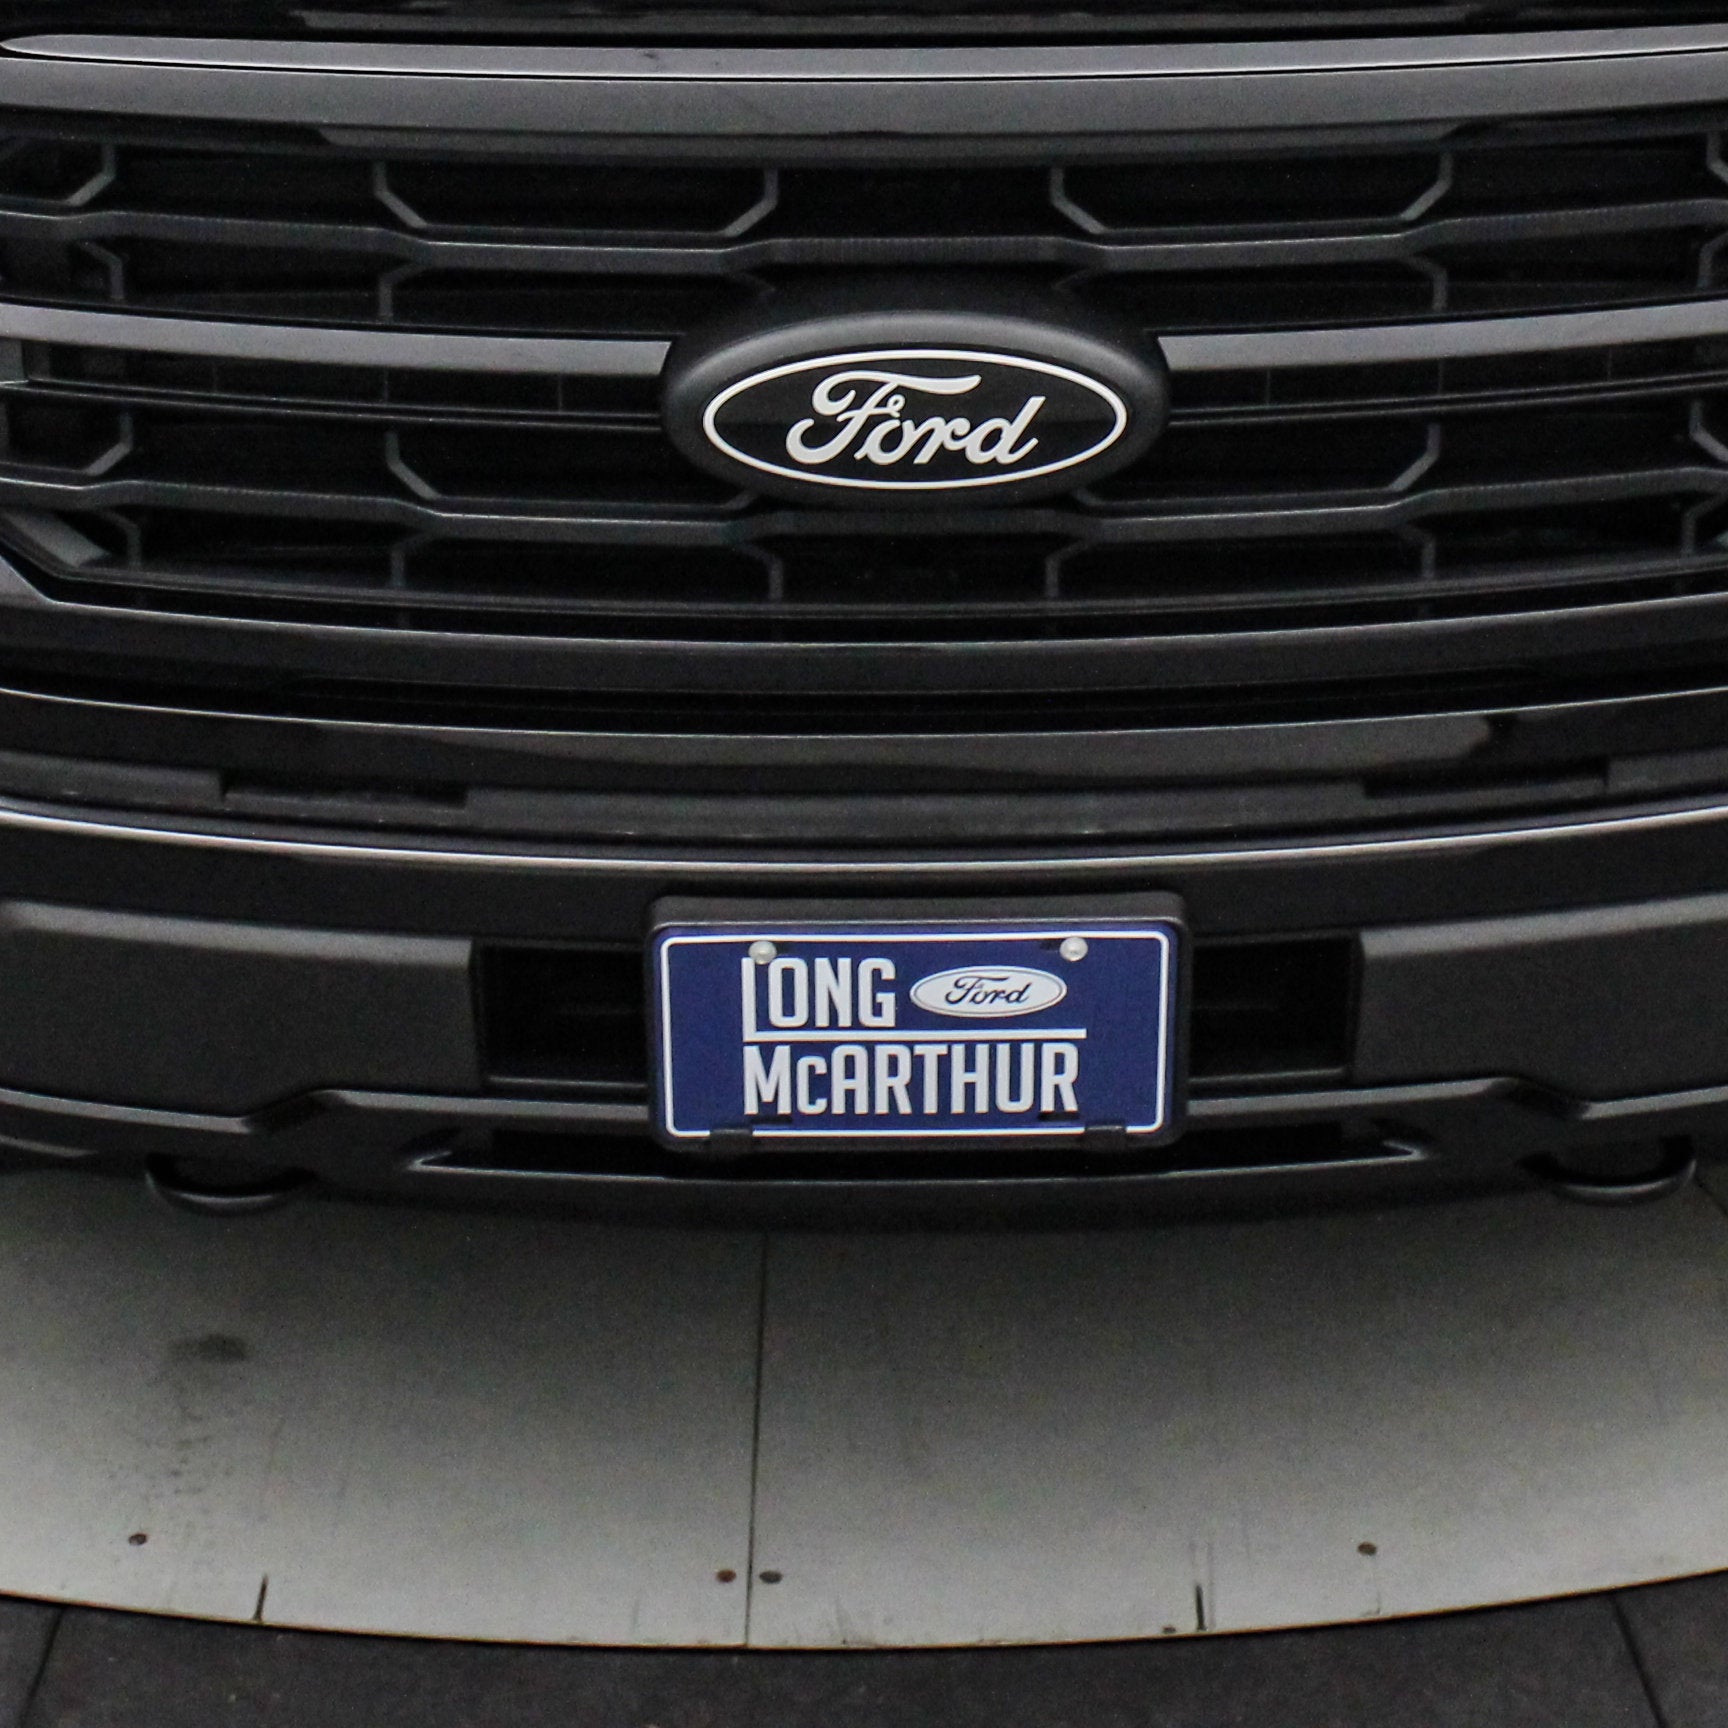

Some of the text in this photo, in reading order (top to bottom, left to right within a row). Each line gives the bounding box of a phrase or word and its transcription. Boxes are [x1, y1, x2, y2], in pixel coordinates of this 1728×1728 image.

[785, 369, 1047, 466] Ford
[741, 957, 1033, 1040] LONG Ford
[742, 1042, 1080, 1115] McARTHUR
